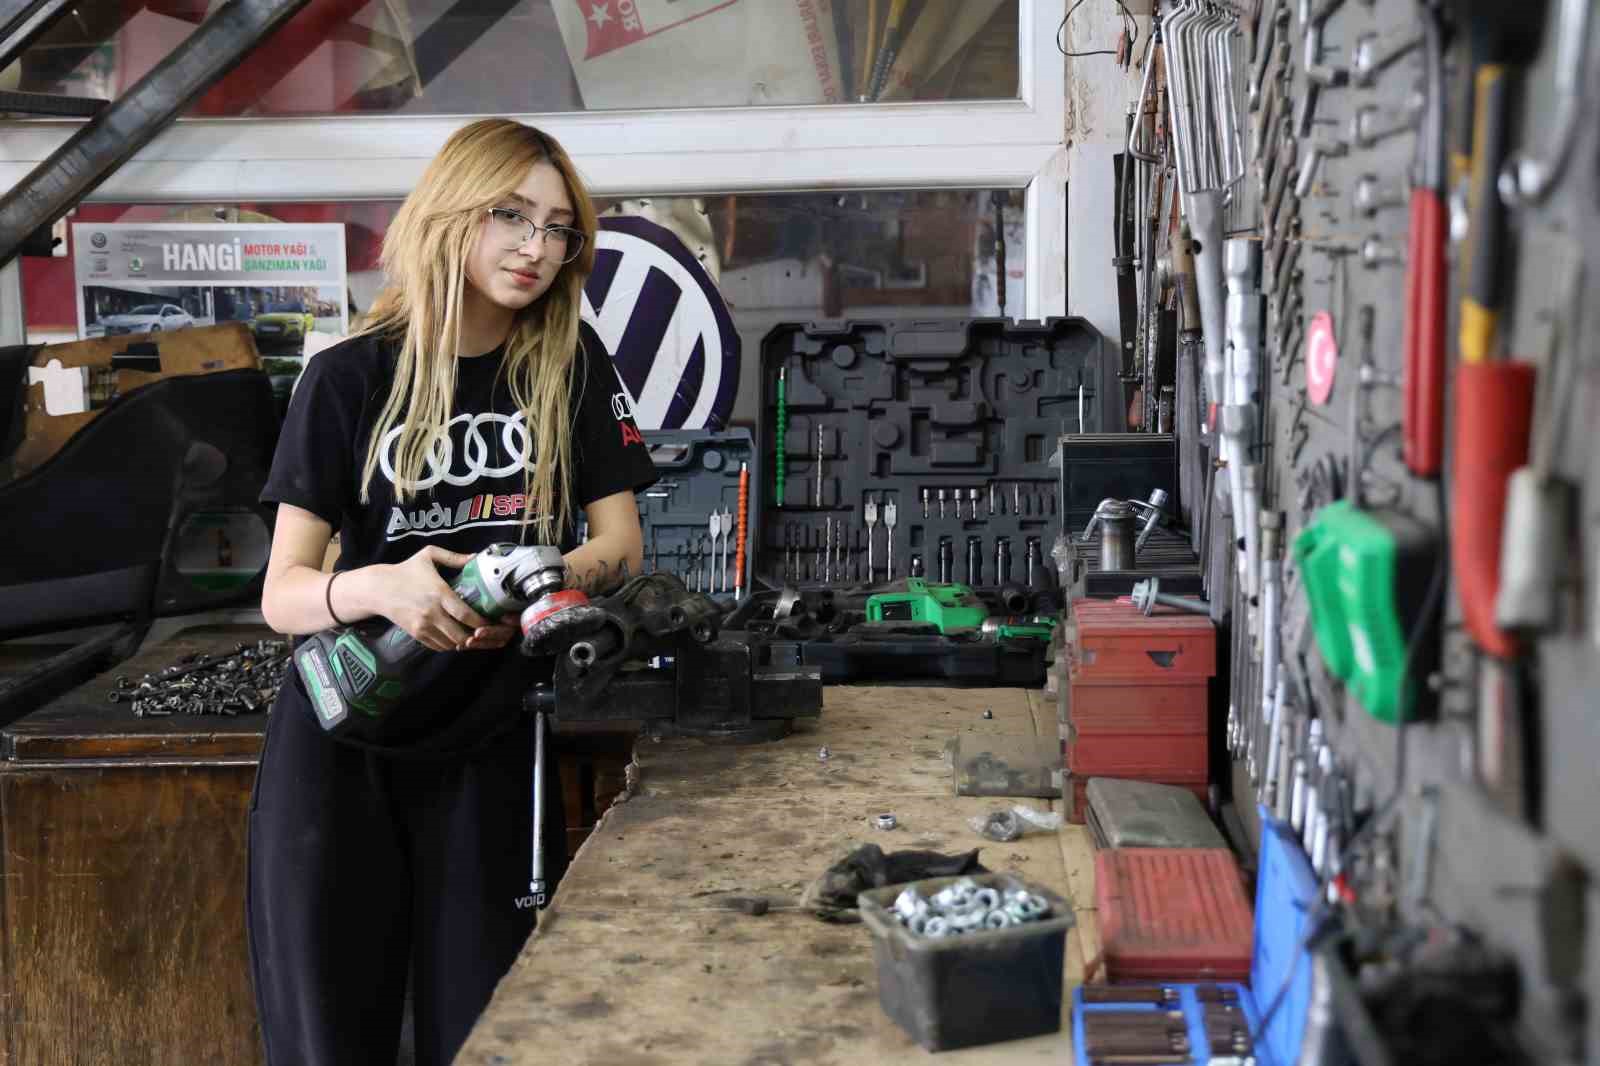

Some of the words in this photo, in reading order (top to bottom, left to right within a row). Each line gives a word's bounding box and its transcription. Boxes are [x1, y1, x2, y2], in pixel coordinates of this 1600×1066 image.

[162, 237, 241, 271] HANGİ
[244, 244, 281, 256] MOTOR
[514, 893, 545, 909] VOID
